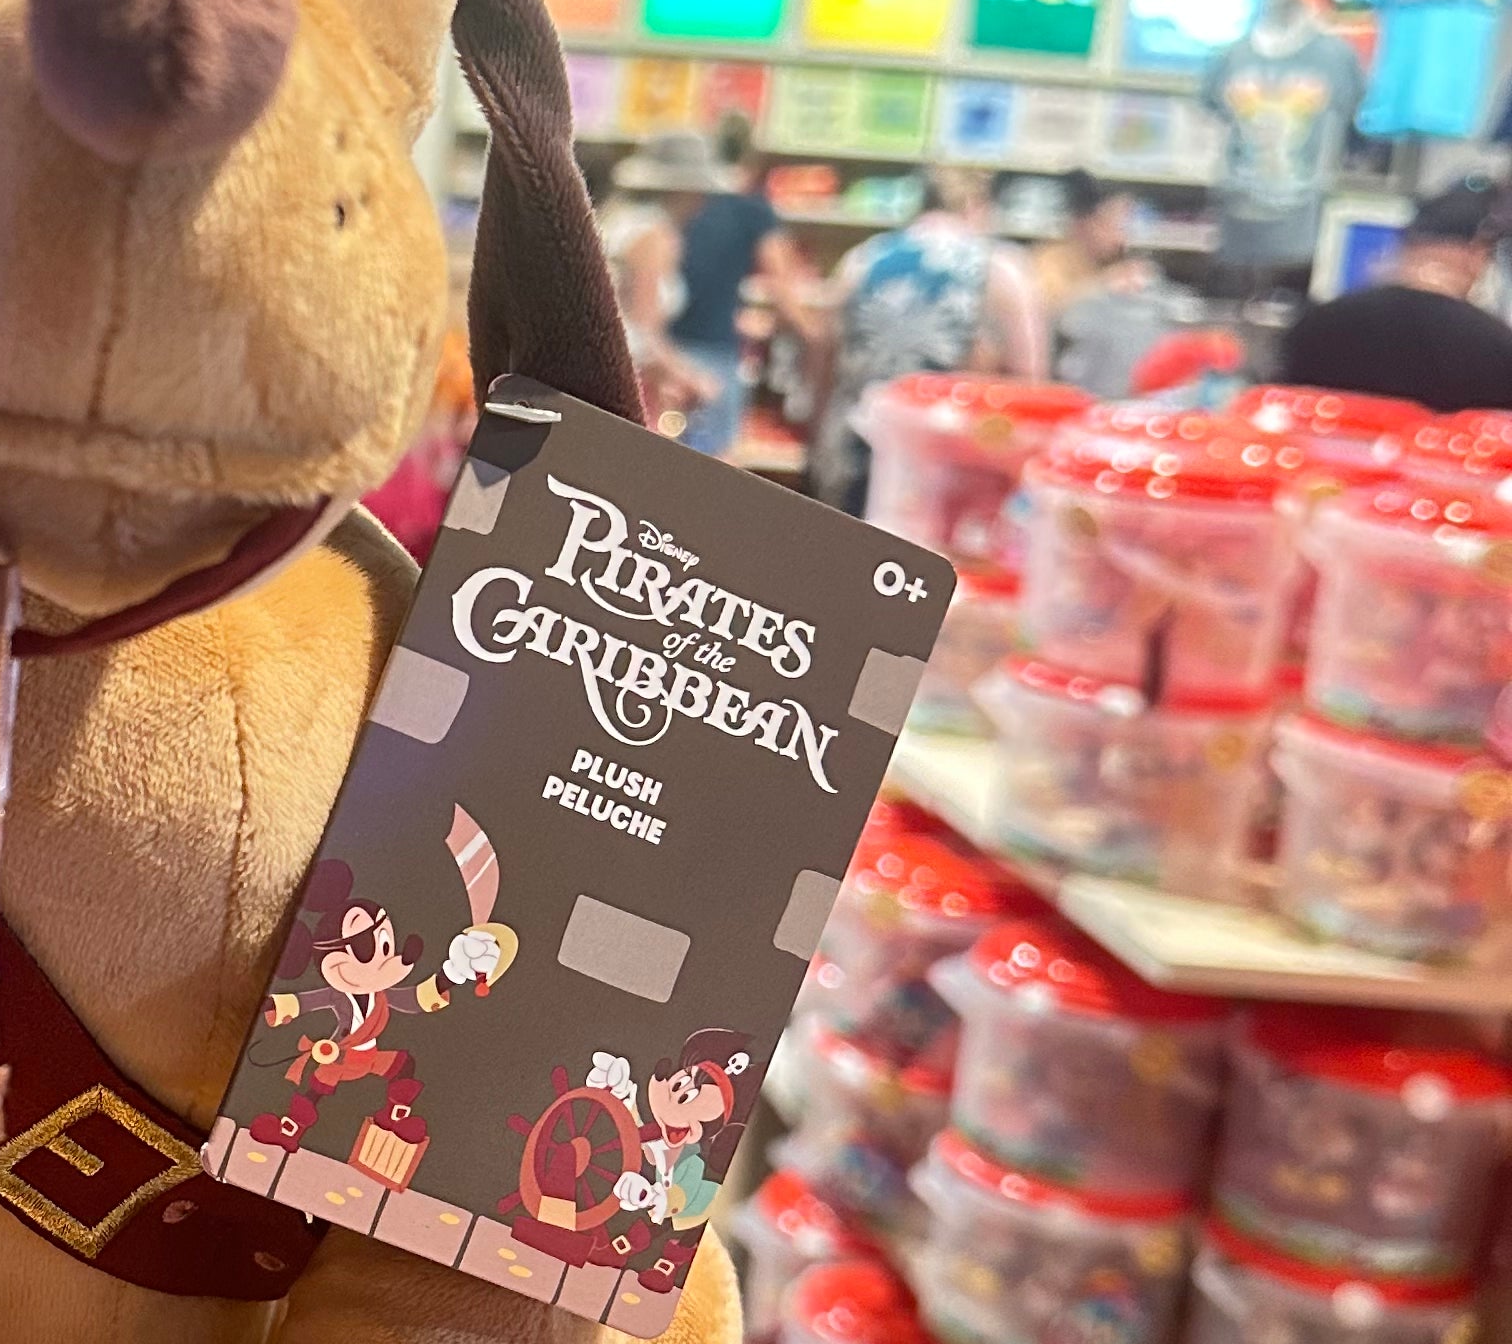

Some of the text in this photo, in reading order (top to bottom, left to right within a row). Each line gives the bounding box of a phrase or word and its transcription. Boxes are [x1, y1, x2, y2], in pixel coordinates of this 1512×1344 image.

[544, 473, 816, 679] PIRATES
[451, 567, 839, 794] CARIBBEAN
[662, 632, 737, 673] of the
[542, 775, 667, 846] PELUCHE
[570, 749, 664, 806] PLUSH
